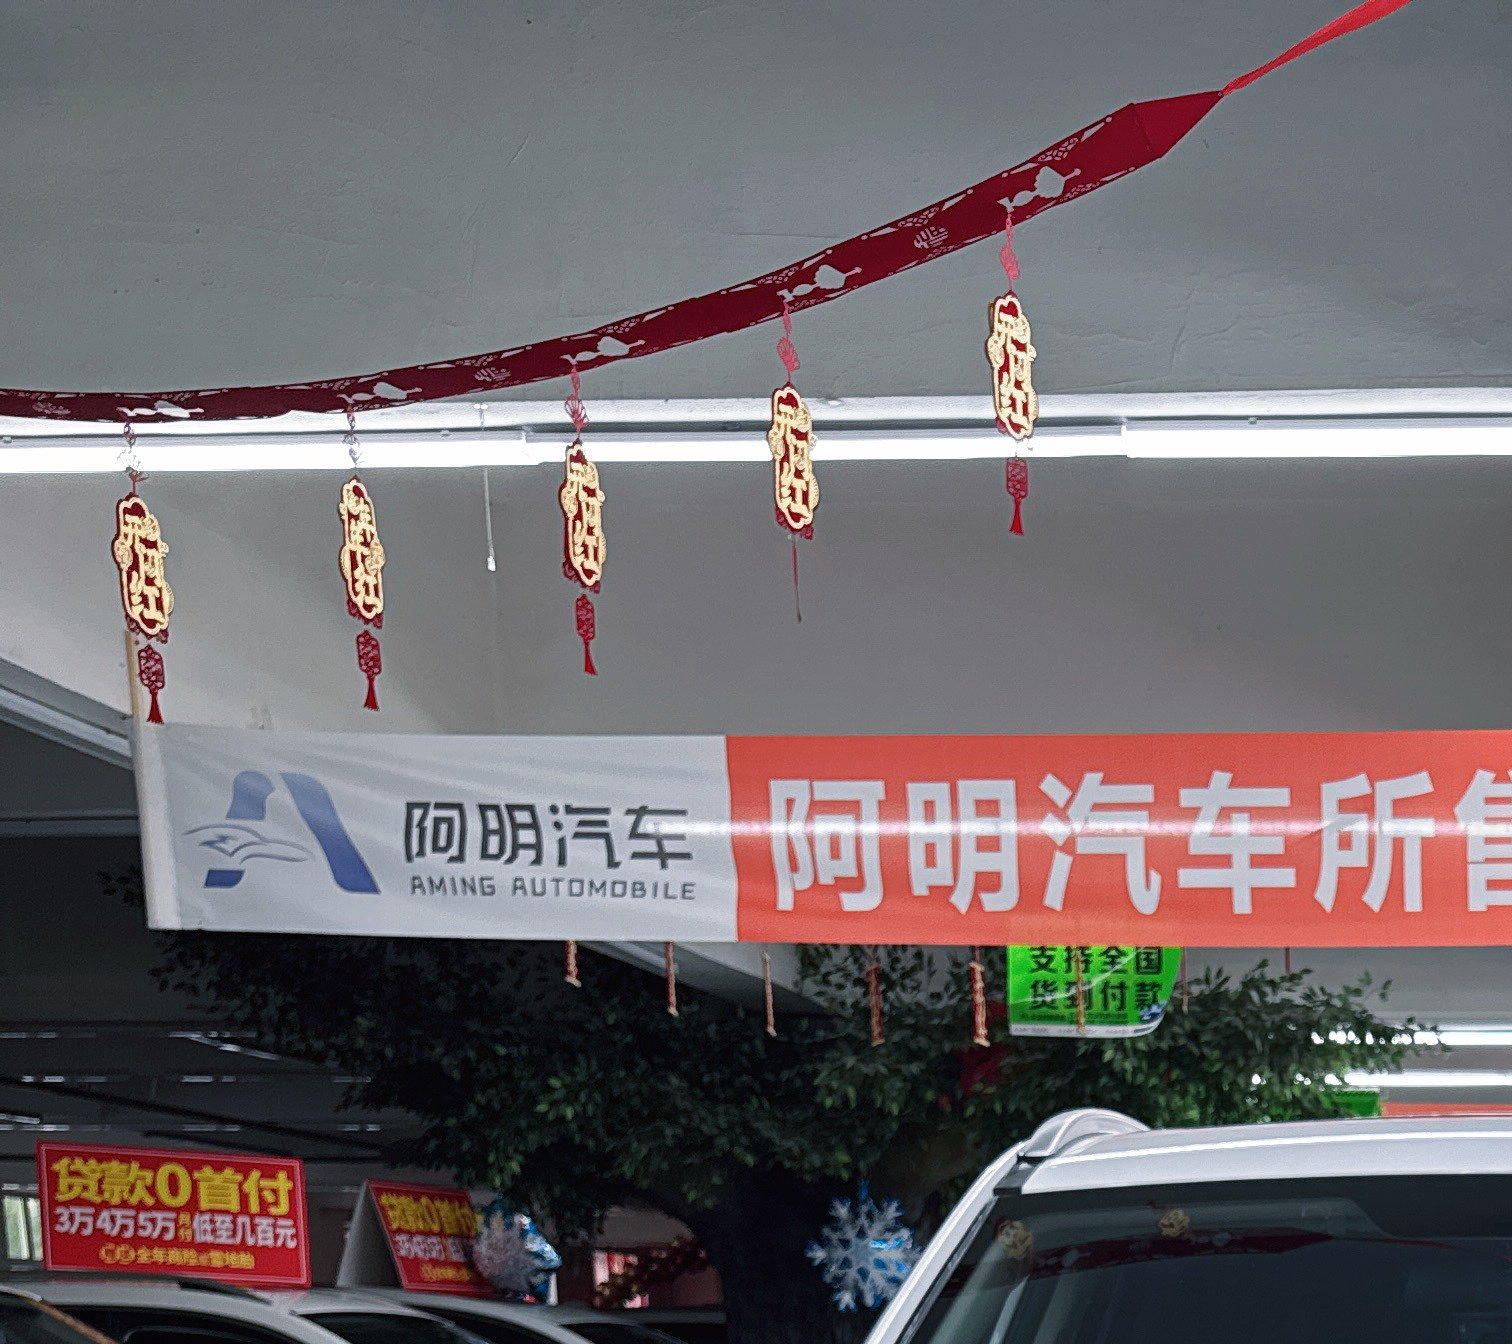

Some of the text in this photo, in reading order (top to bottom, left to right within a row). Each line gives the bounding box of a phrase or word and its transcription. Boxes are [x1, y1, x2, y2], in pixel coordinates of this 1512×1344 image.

[404, 802, 694, 870] 阿明汽车
[410, 875, 697, 902] AMING AUTOMOBILE
[51, 1156, 294, 1217] 贷款0首付
